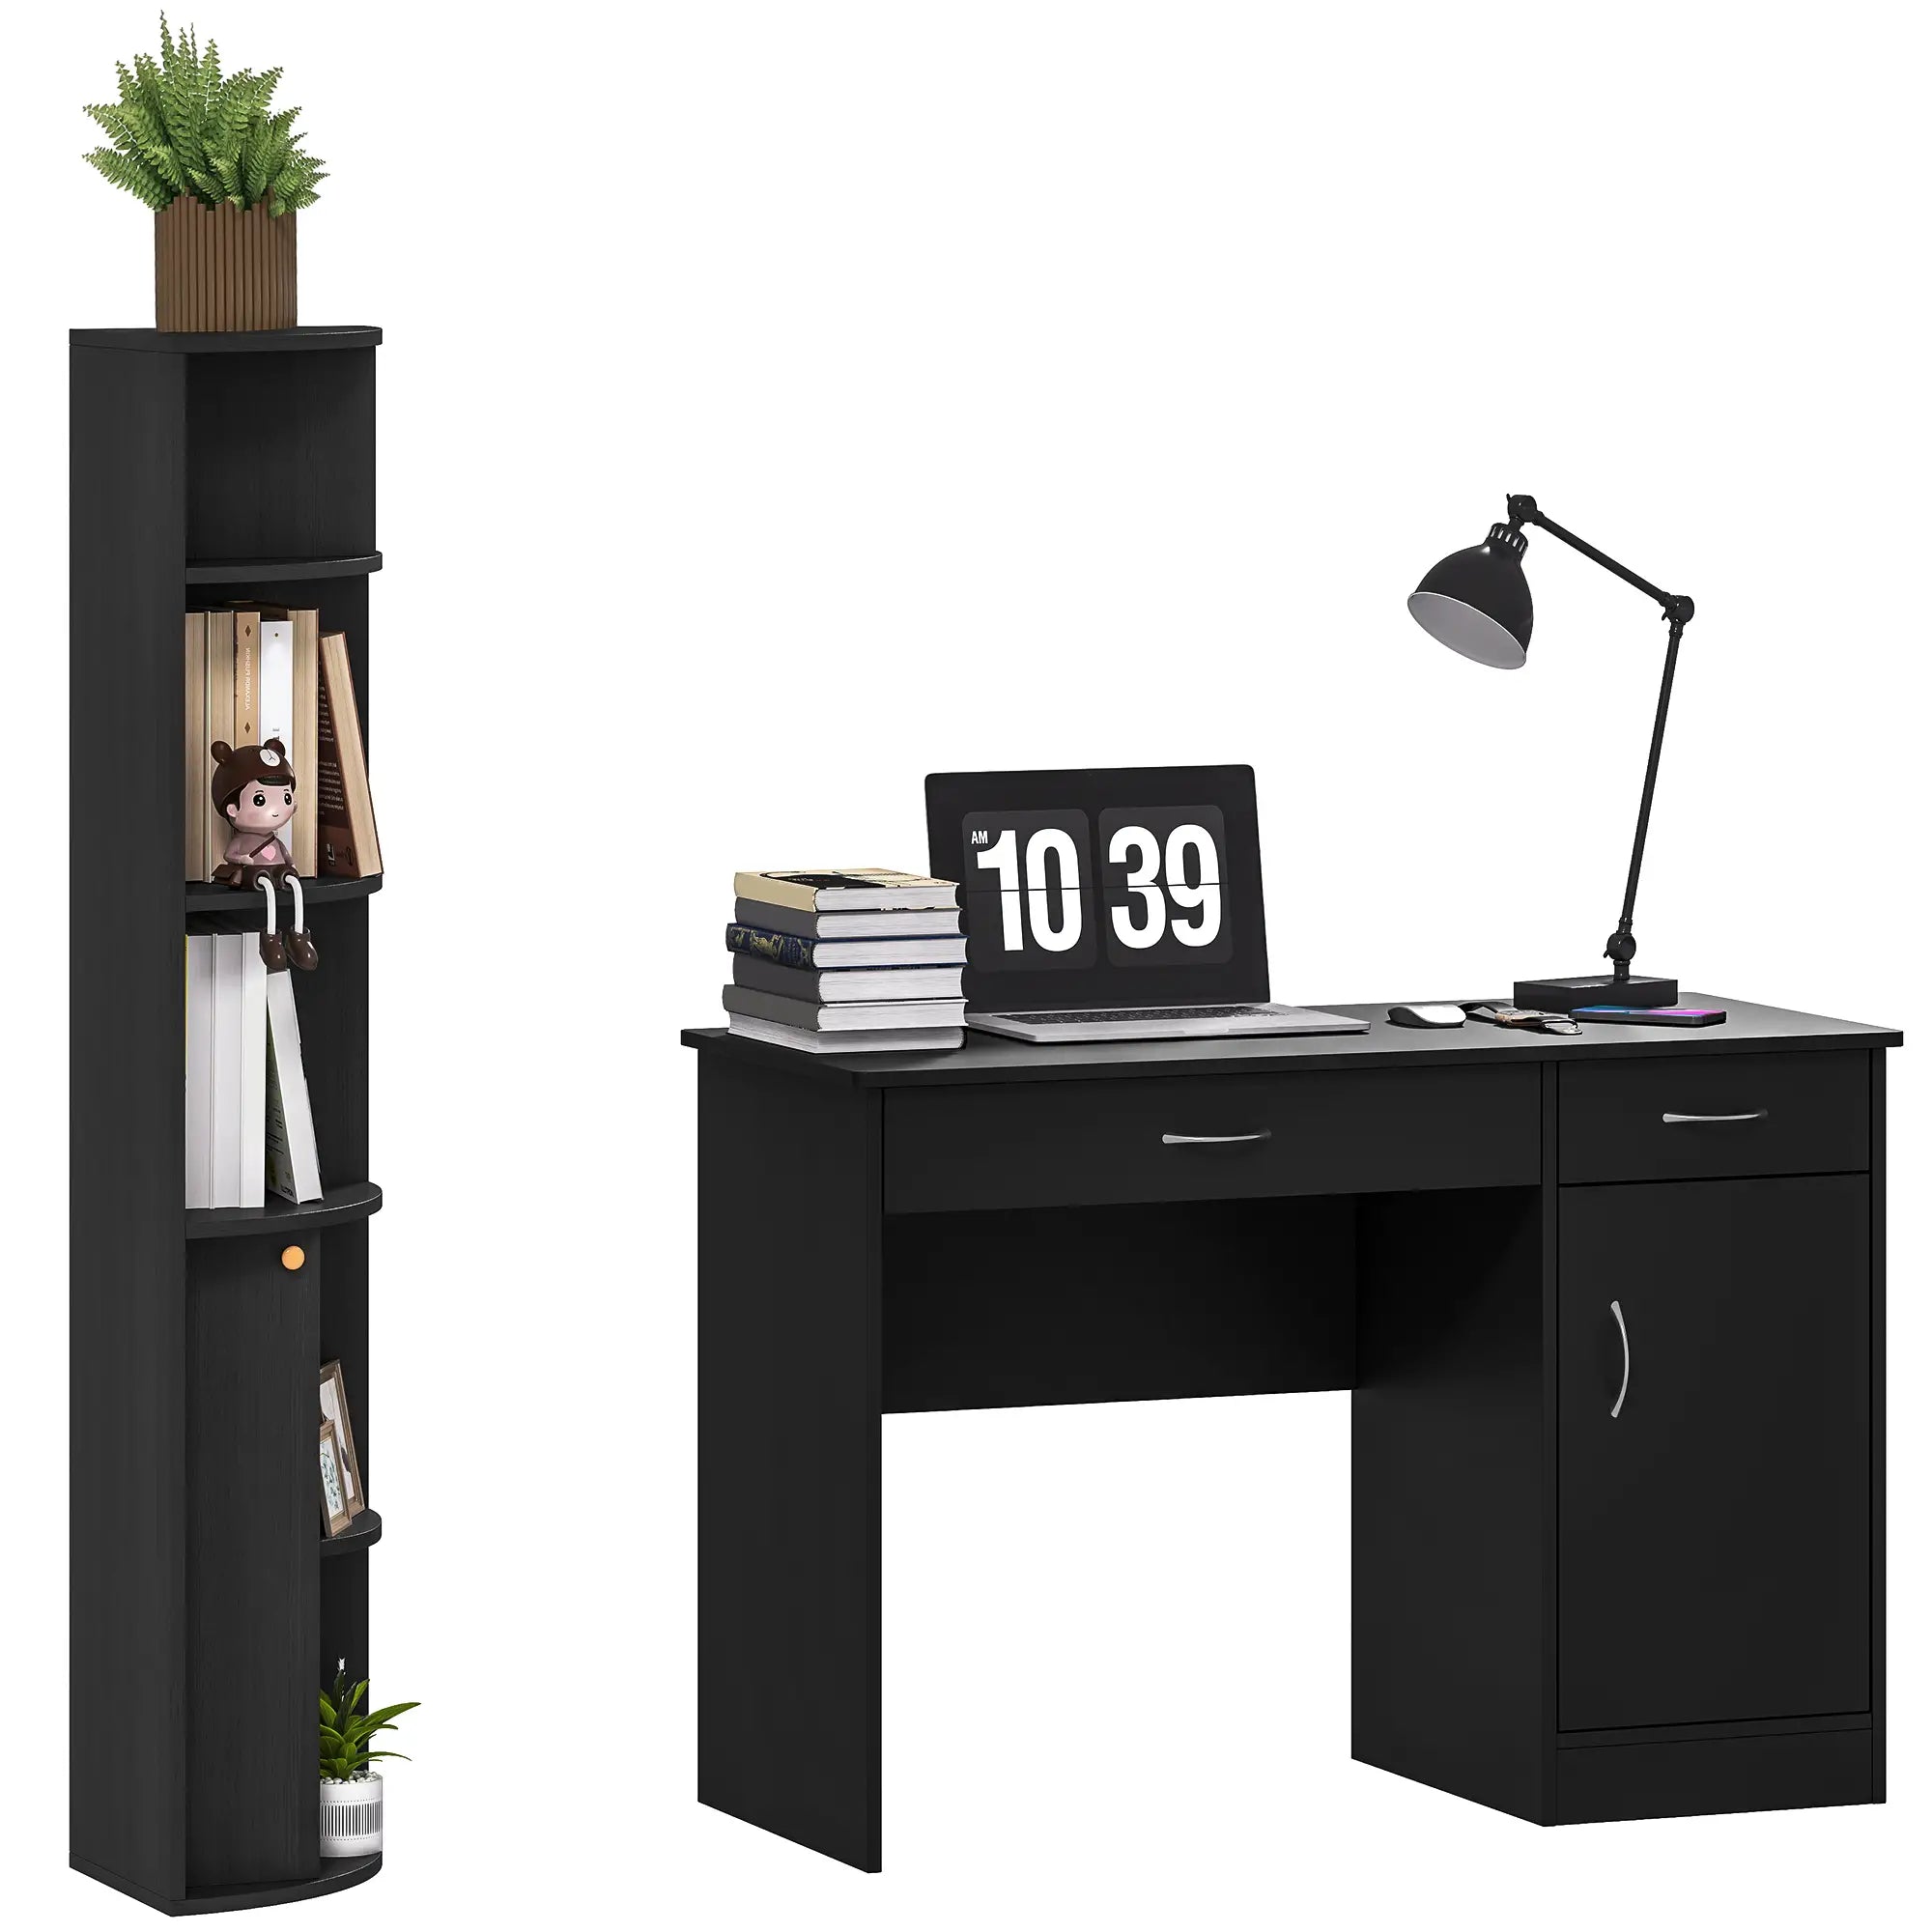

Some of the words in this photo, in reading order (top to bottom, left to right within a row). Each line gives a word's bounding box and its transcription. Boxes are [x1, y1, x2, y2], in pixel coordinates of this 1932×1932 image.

[971, 830, 988, 845] AM
[977, 828, 1083, 952] 10
[1108, 824, 1221, 950] 39
